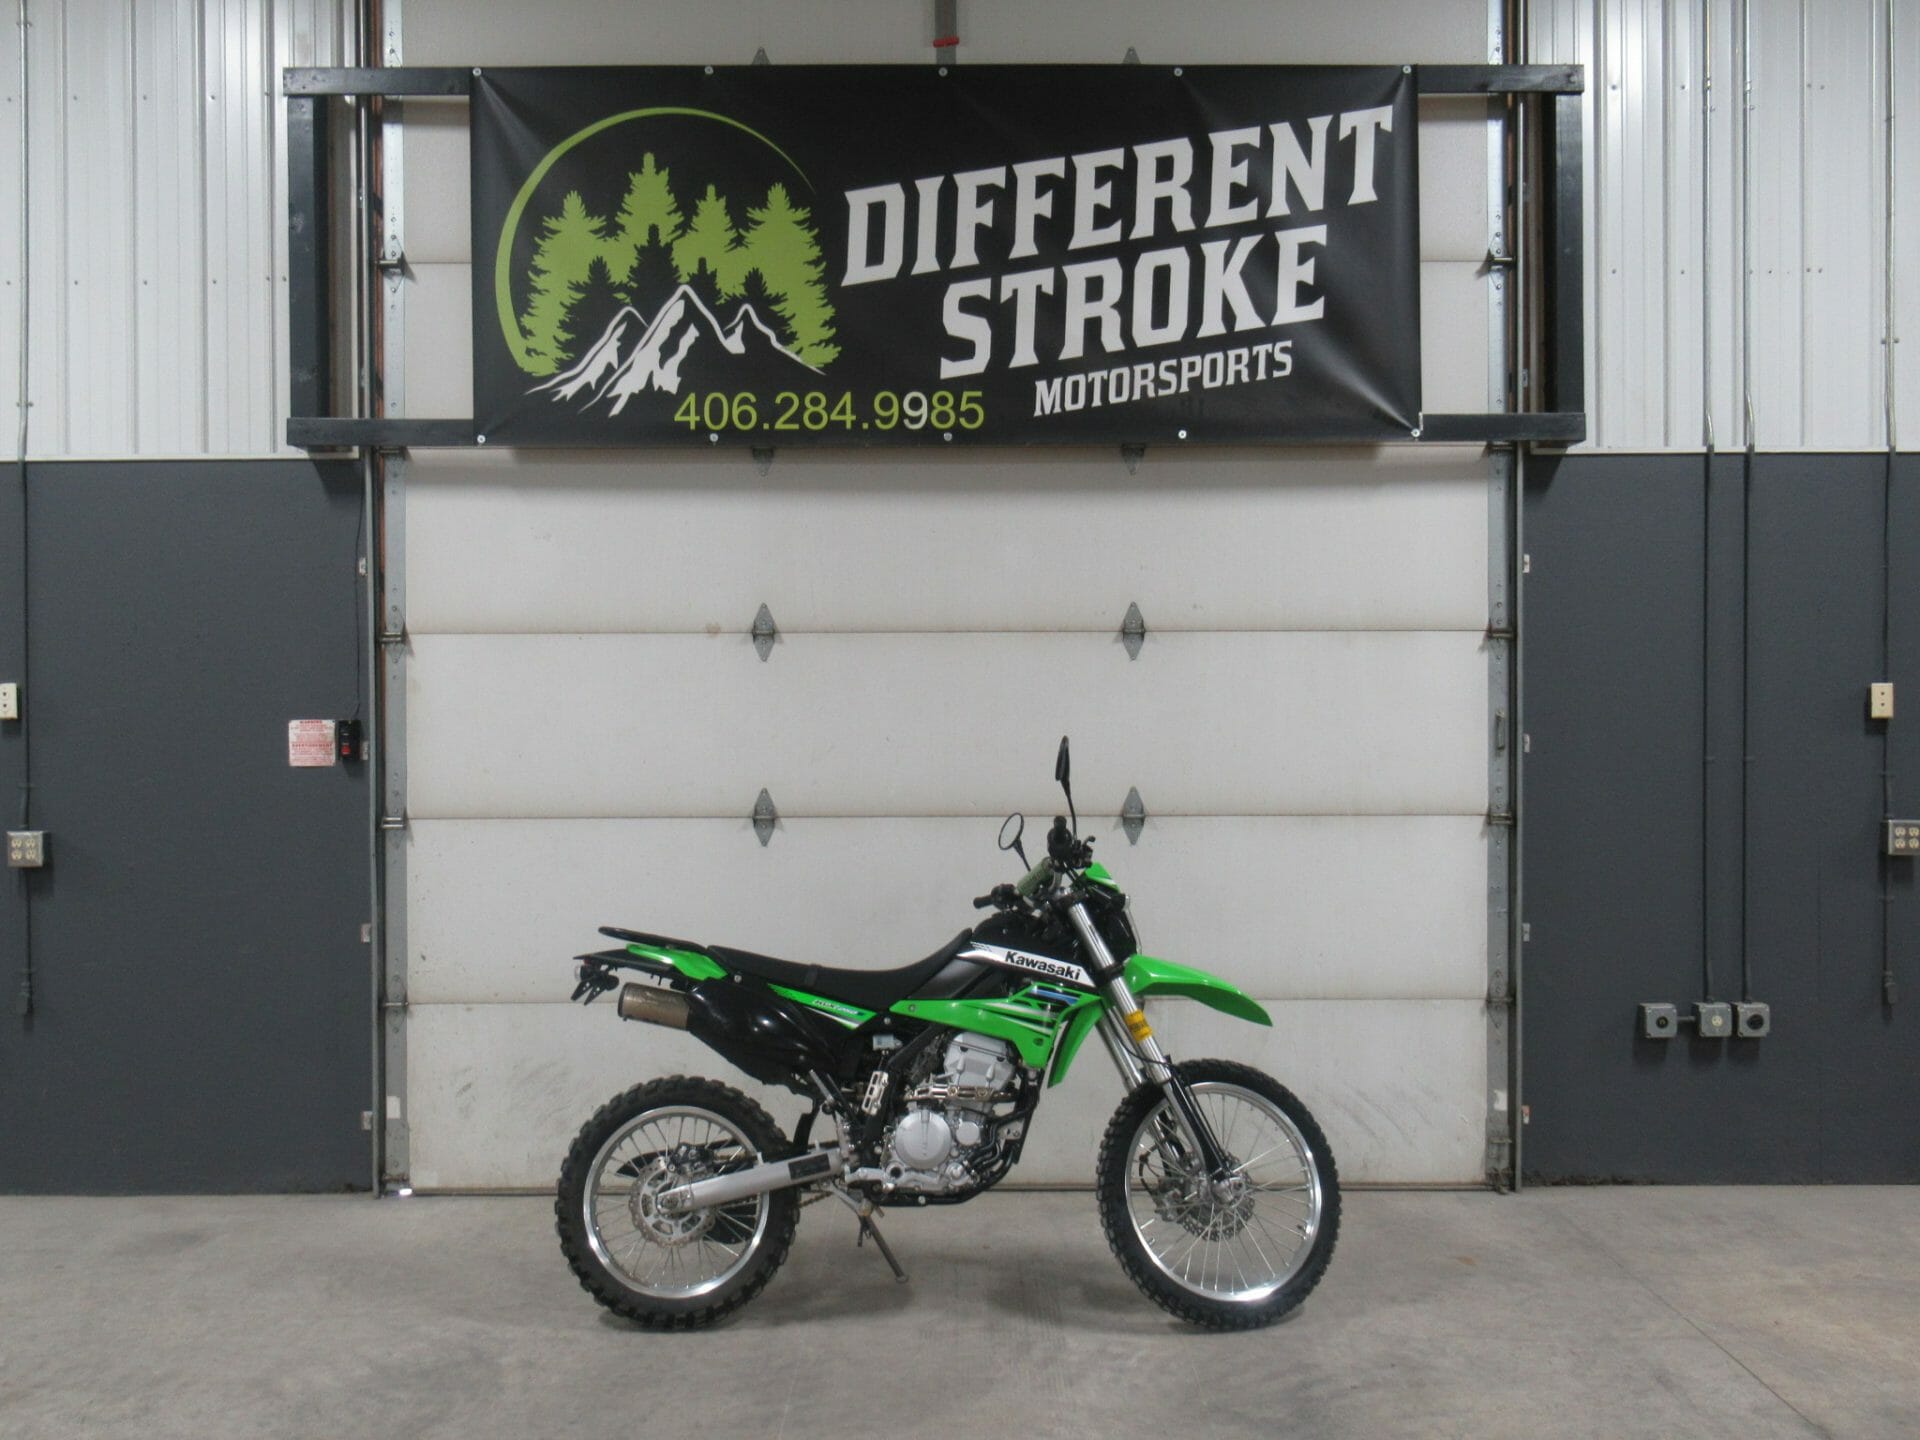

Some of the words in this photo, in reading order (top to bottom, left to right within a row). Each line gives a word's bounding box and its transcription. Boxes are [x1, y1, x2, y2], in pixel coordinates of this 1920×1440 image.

[841, 104, 1394, 287] DIFFERENT
[940, 224, 1328, 380] STROKE
[673, 390, 985, 431] 406.284.9985
[1033, 339, 1294, 418] MOTORSPORTS
[1004, 950, 1081, 981] Kawasaki
